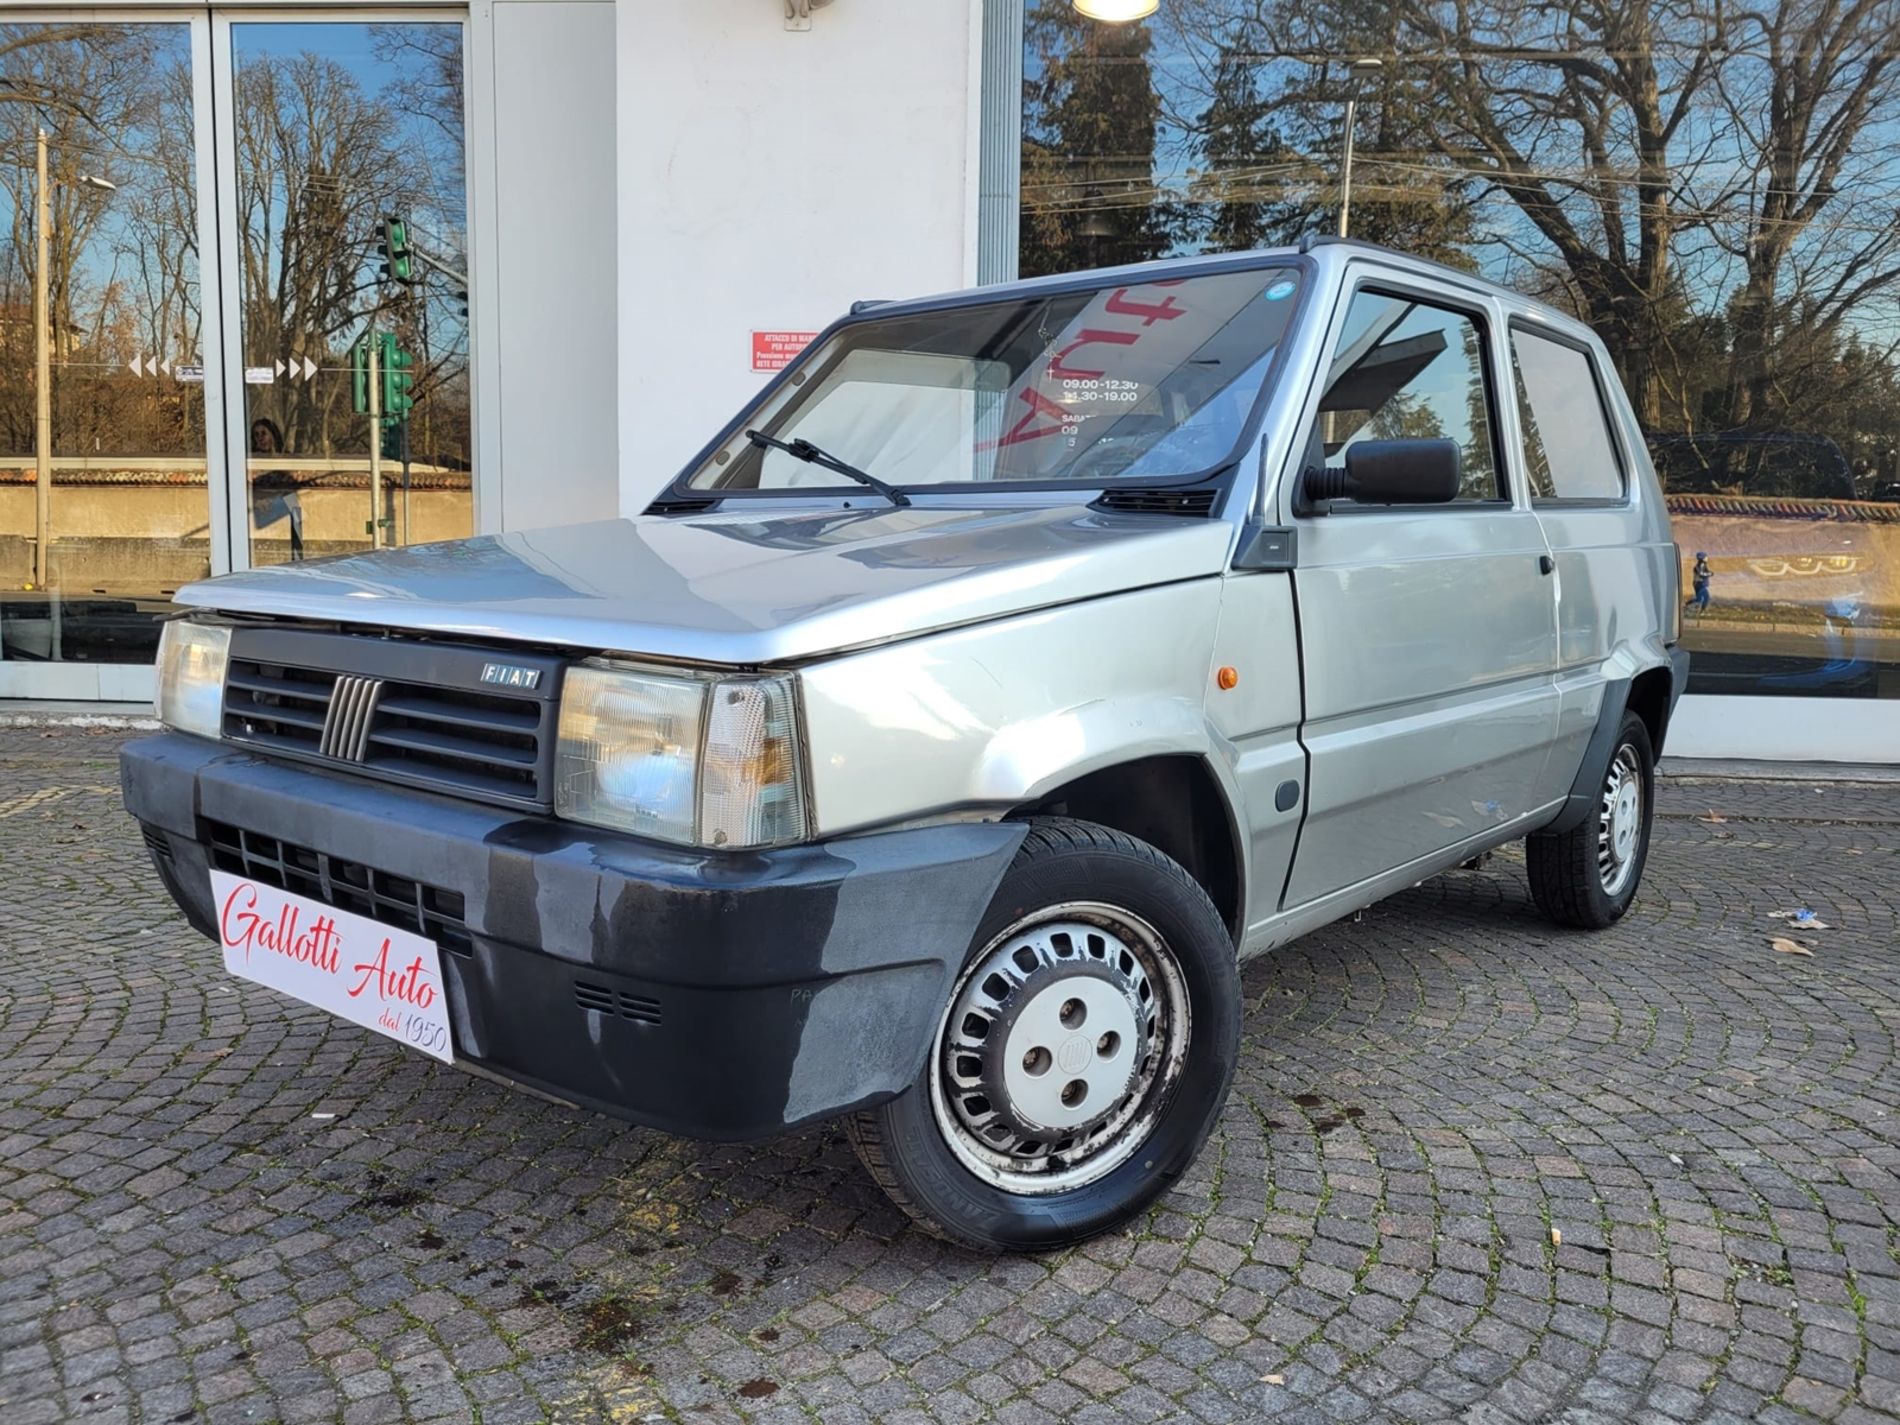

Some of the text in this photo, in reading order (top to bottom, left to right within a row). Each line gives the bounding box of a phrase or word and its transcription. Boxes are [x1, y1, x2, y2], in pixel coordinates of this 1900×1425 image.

[485, 664, 537, 686] FIAT
[222, 883, 438, 1008] Gallotti Auto
[378, 1008, 447, 1052] dal 1950
